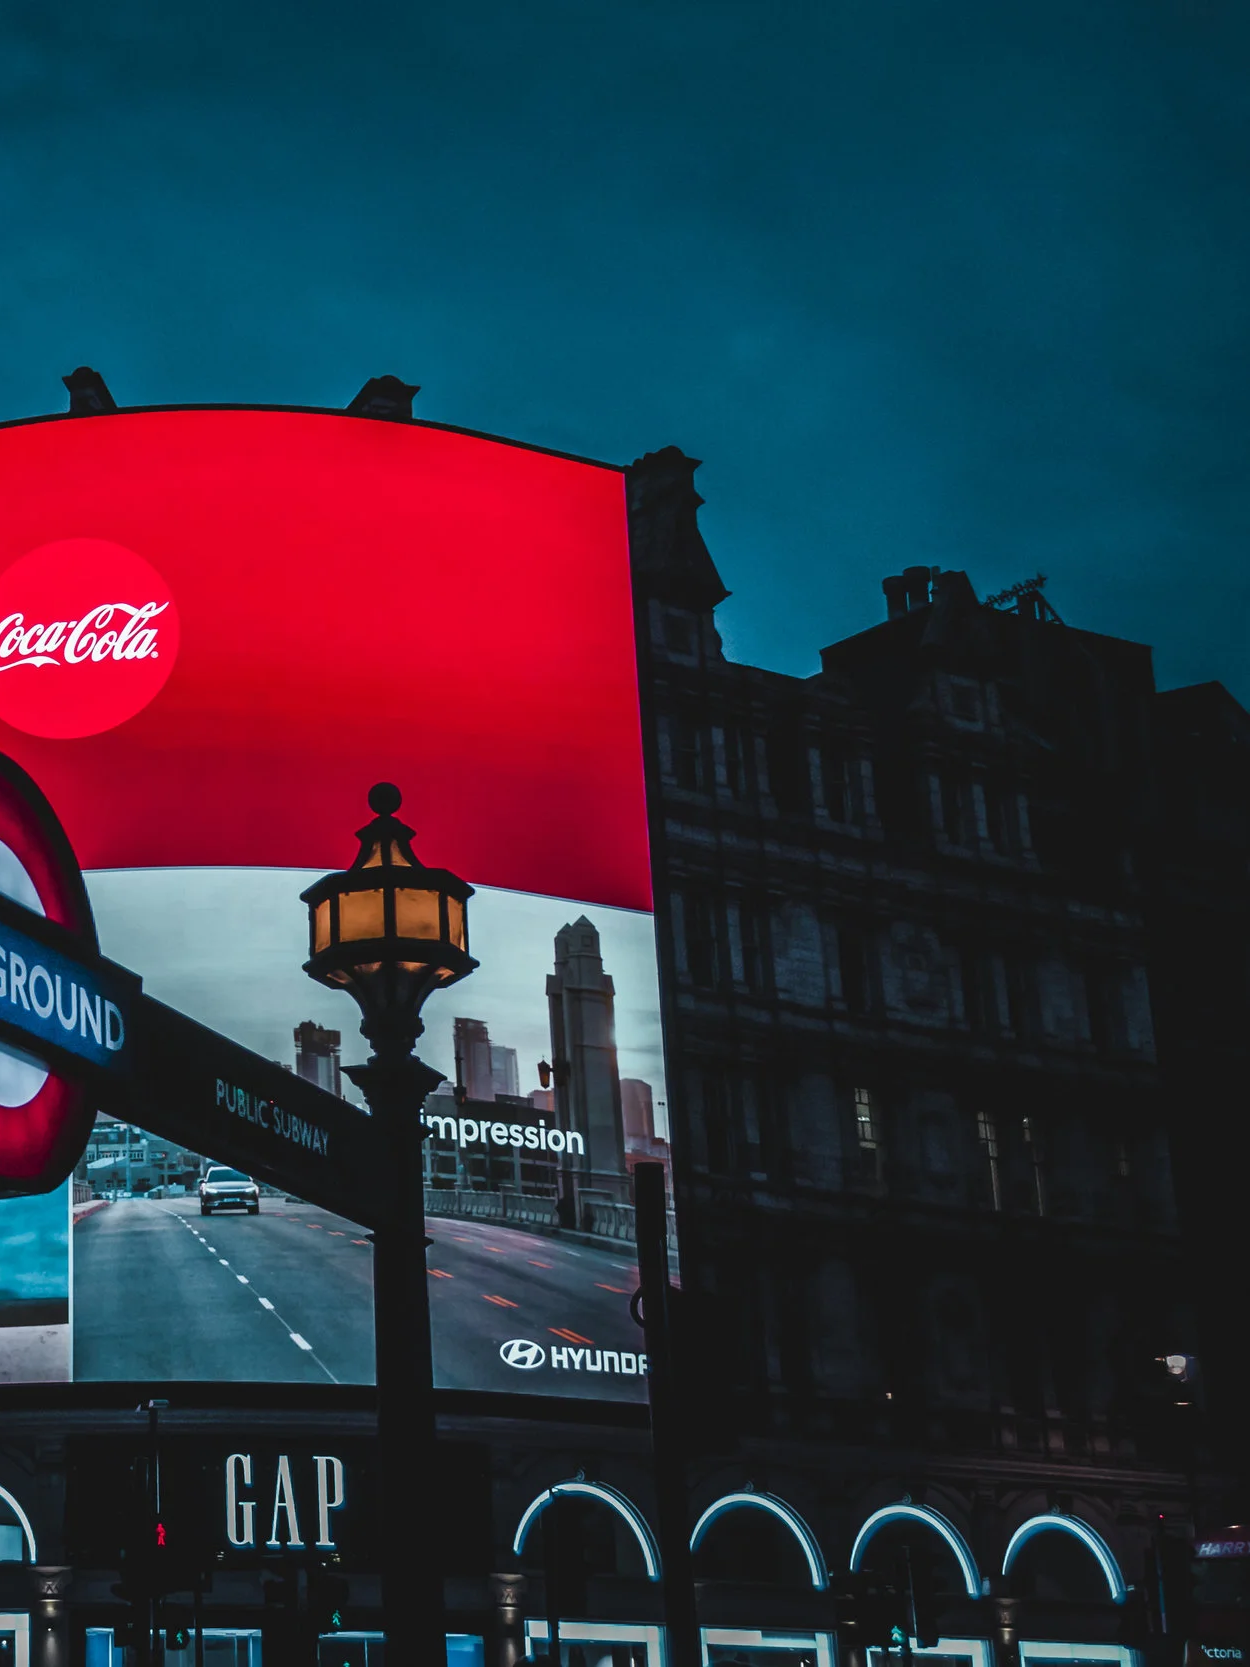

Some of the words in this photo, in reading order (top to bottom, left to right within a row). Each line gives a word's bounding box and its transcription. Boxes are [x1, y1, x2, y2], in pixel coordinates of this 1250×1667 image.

[216, 1078, 269, 1128] PUBLIC
[273, 1106, 328, 1156] SUBWAY
[419, 1107, 584, 1155] impression
[226, 1453, 346, 1548] GAP
[1198, 1541, 1250, 1556] HARR
